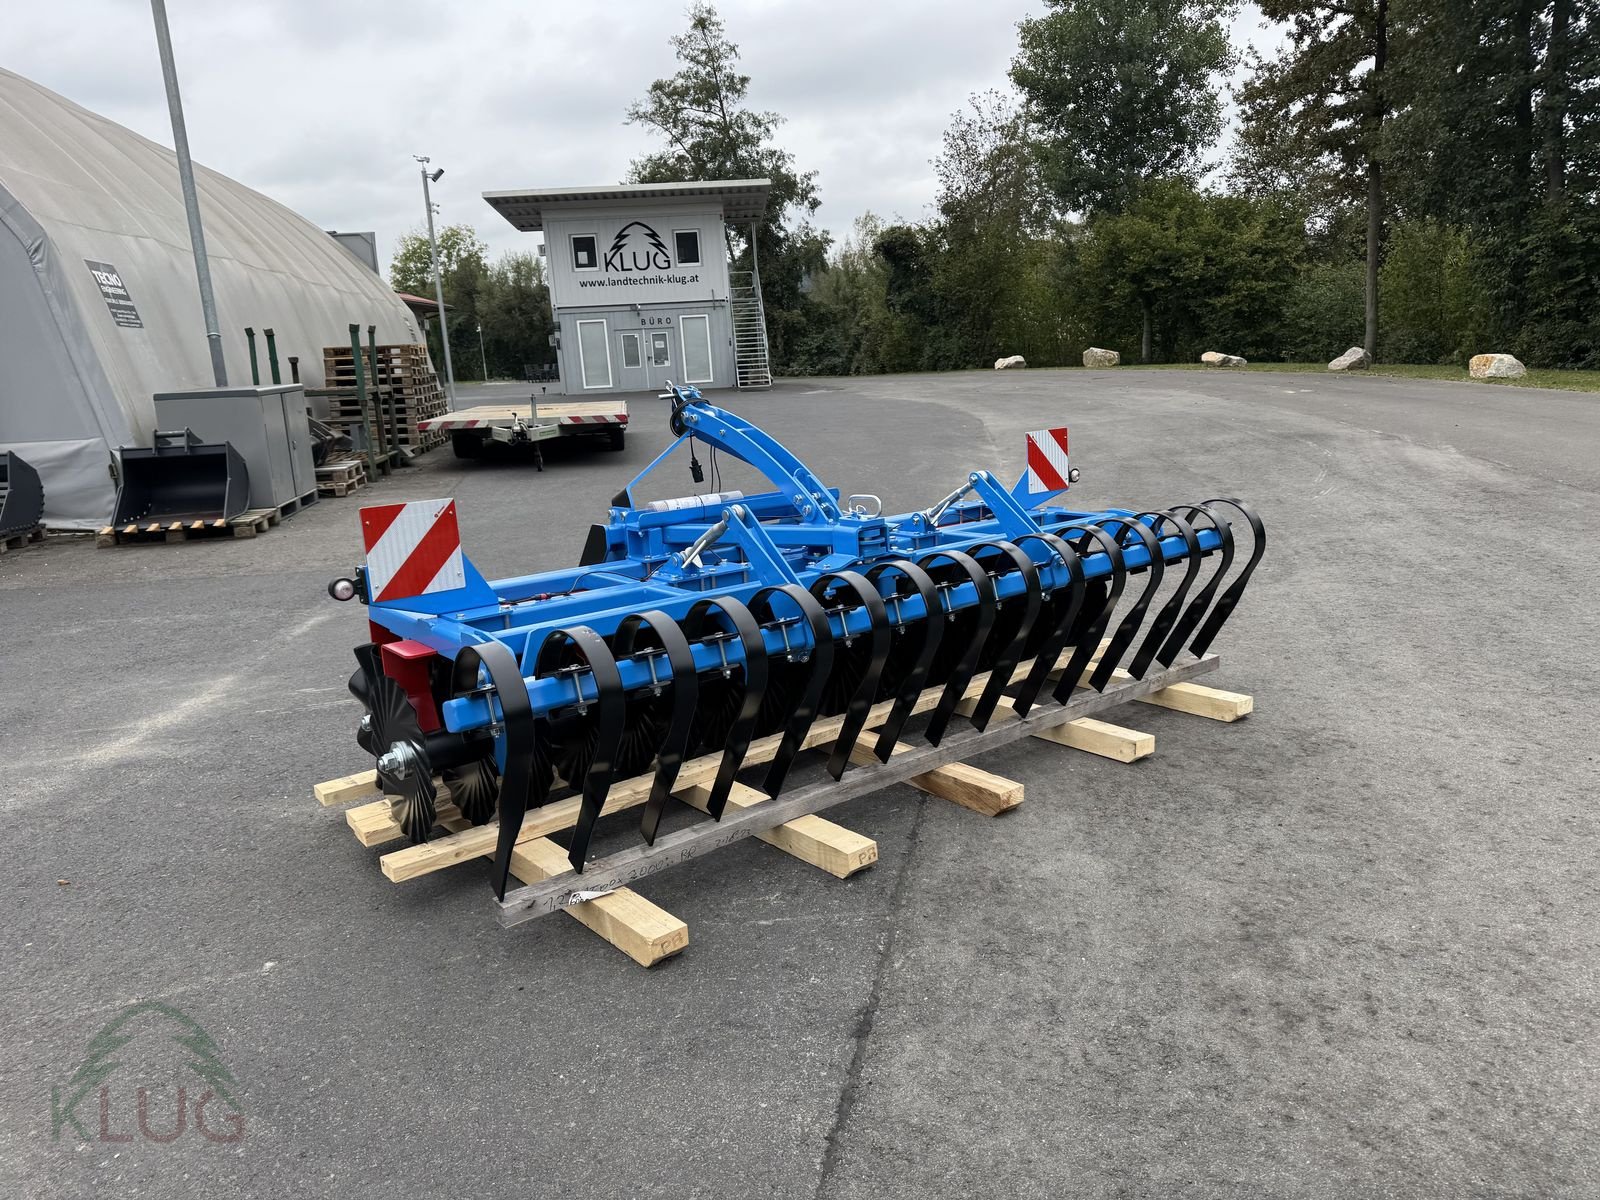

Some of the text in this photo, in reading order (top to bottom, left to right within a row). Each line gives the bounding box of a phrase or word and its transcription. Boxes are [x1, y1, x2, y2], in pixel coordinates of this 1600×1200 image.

[603, 250, 671, 273] KLUG
[91, 270, 122, 287] TECNO
[579, 274, 700, 288] www.landtechnik-klug.at
[640, 316, 672, 326] BÜRO
